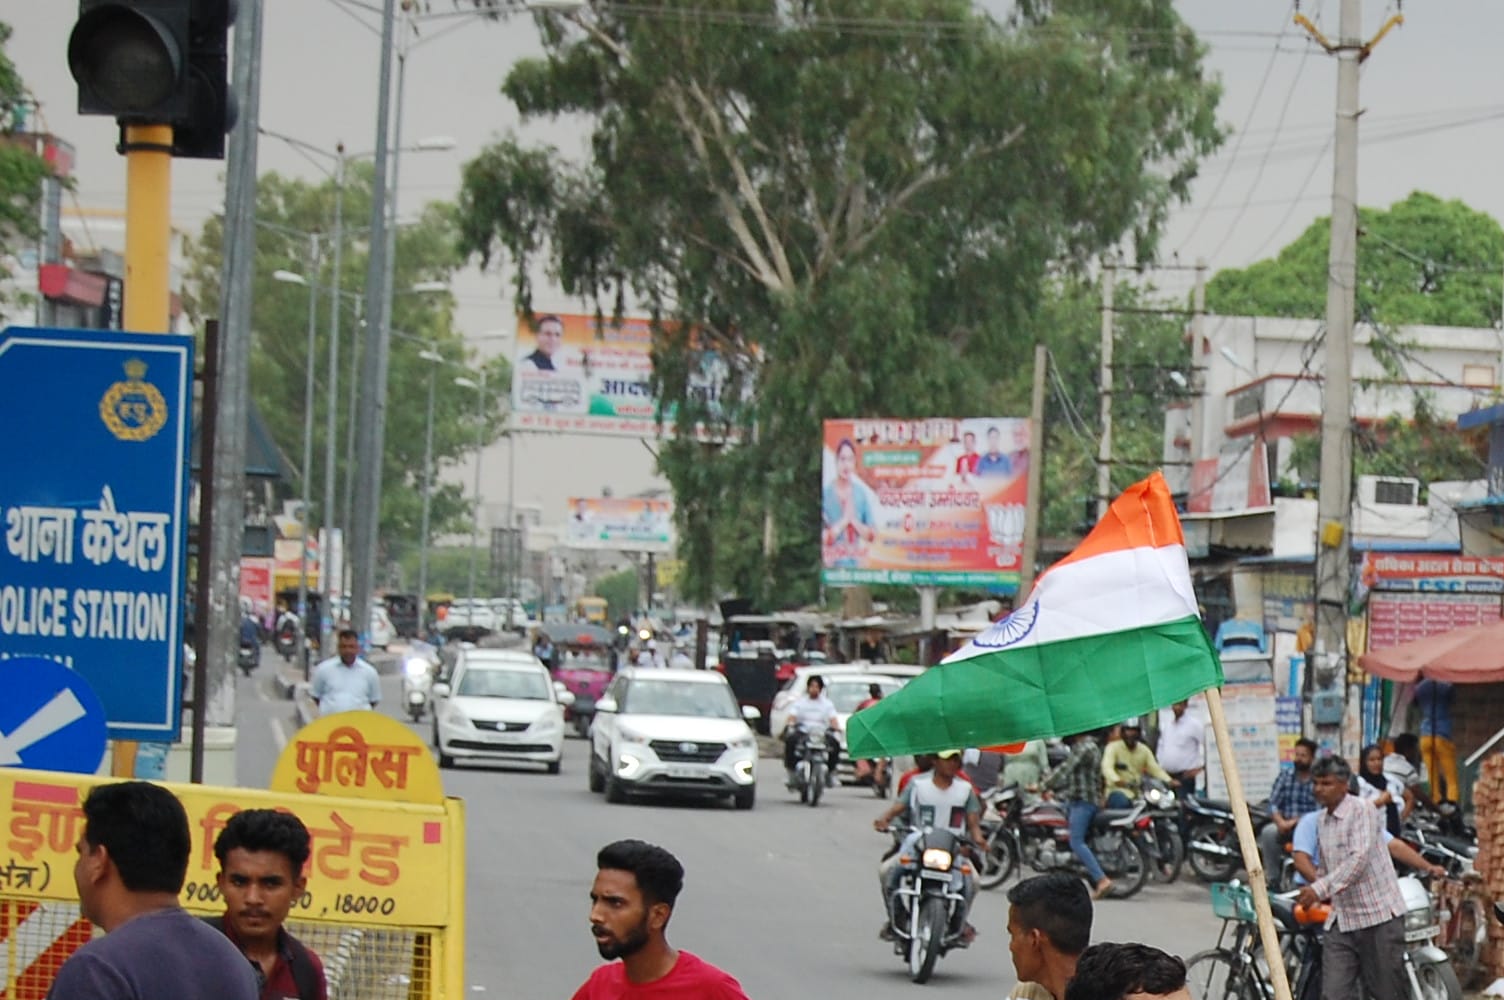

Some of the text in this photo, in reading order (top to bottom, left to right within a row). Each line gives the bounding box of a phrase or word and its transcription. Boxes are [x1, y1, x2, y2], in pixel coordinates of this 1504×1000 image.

[6, 485, 170, 572] थाना कैथल
[0, 584, 167, 642] OLICE STATION
[1419, 577, 1461, 592] CSC
[295, 727, 421, 794] पुलिस
